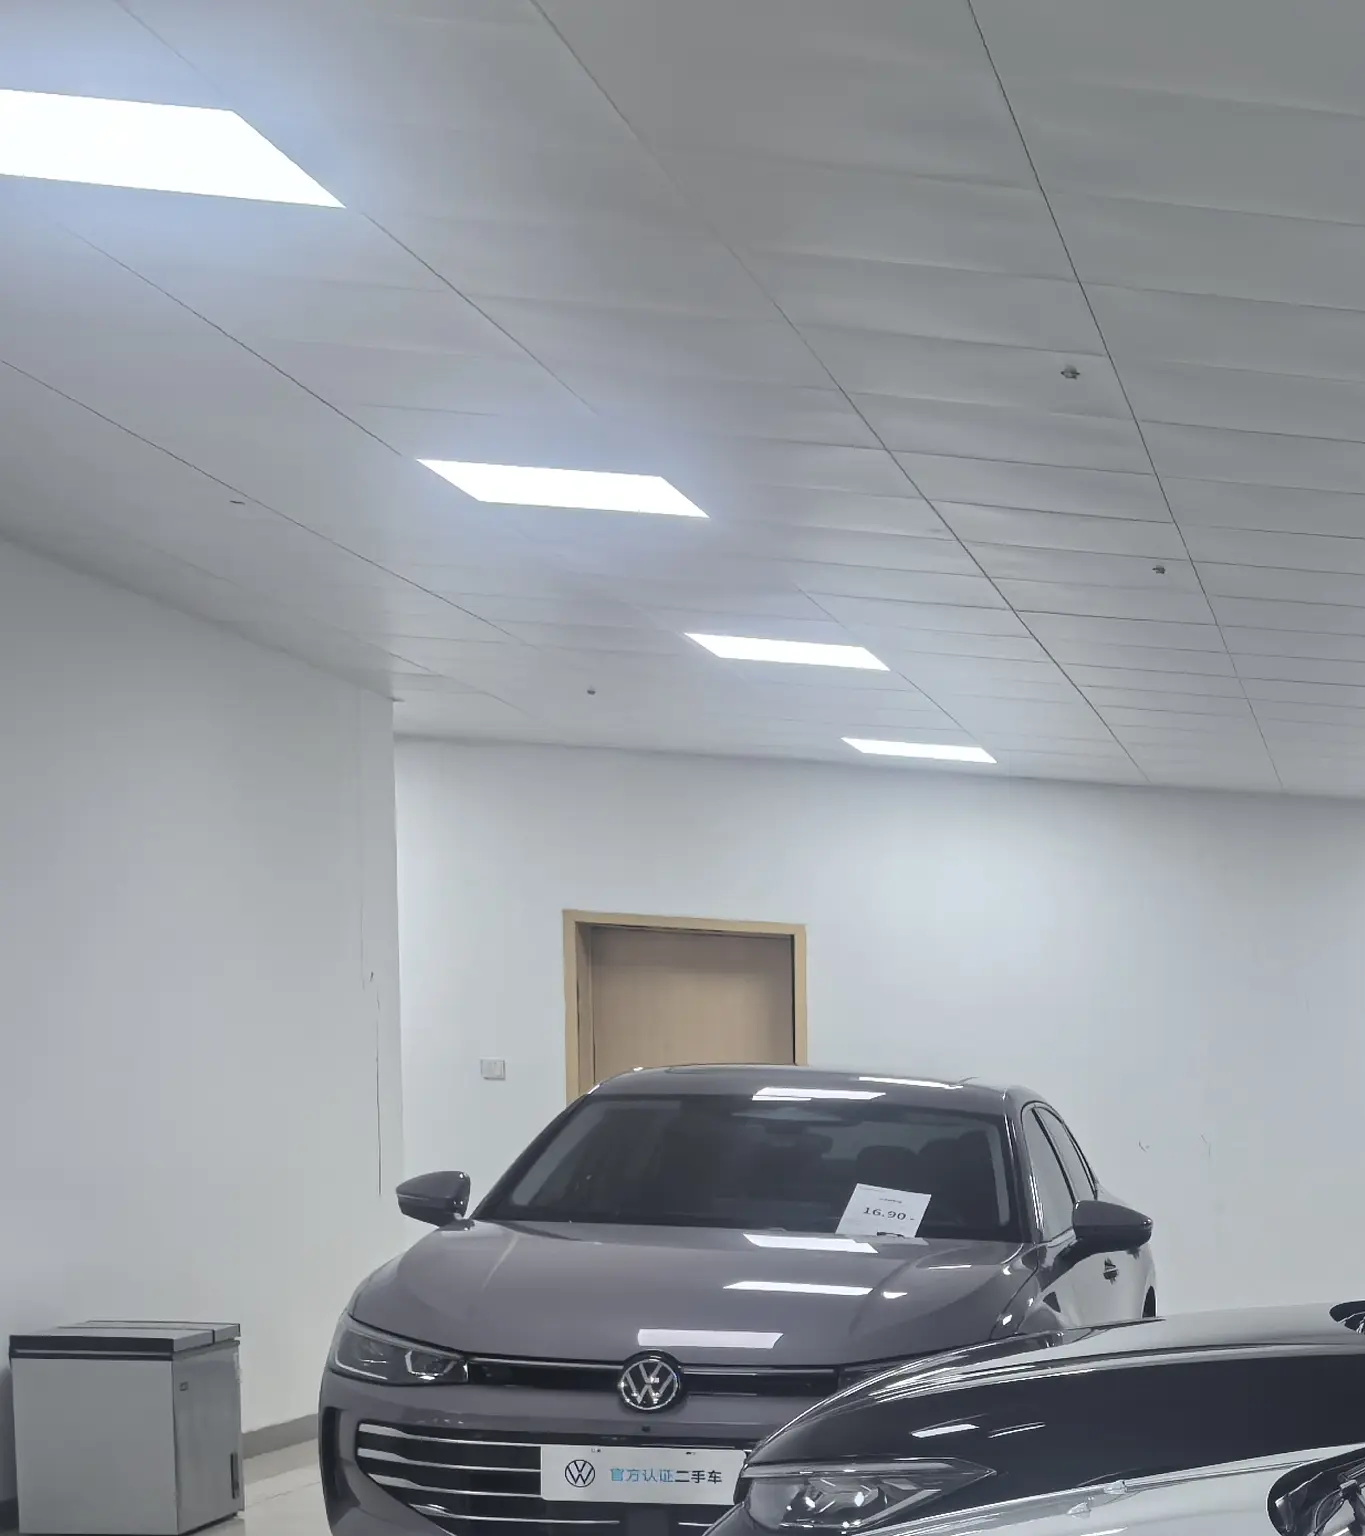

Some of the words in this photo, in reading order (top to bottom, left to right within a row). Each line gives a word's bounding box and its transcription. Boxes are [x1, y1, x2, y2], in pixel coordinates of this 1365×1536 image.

[610, 1467, 723, 1485] 官方认证二手车
